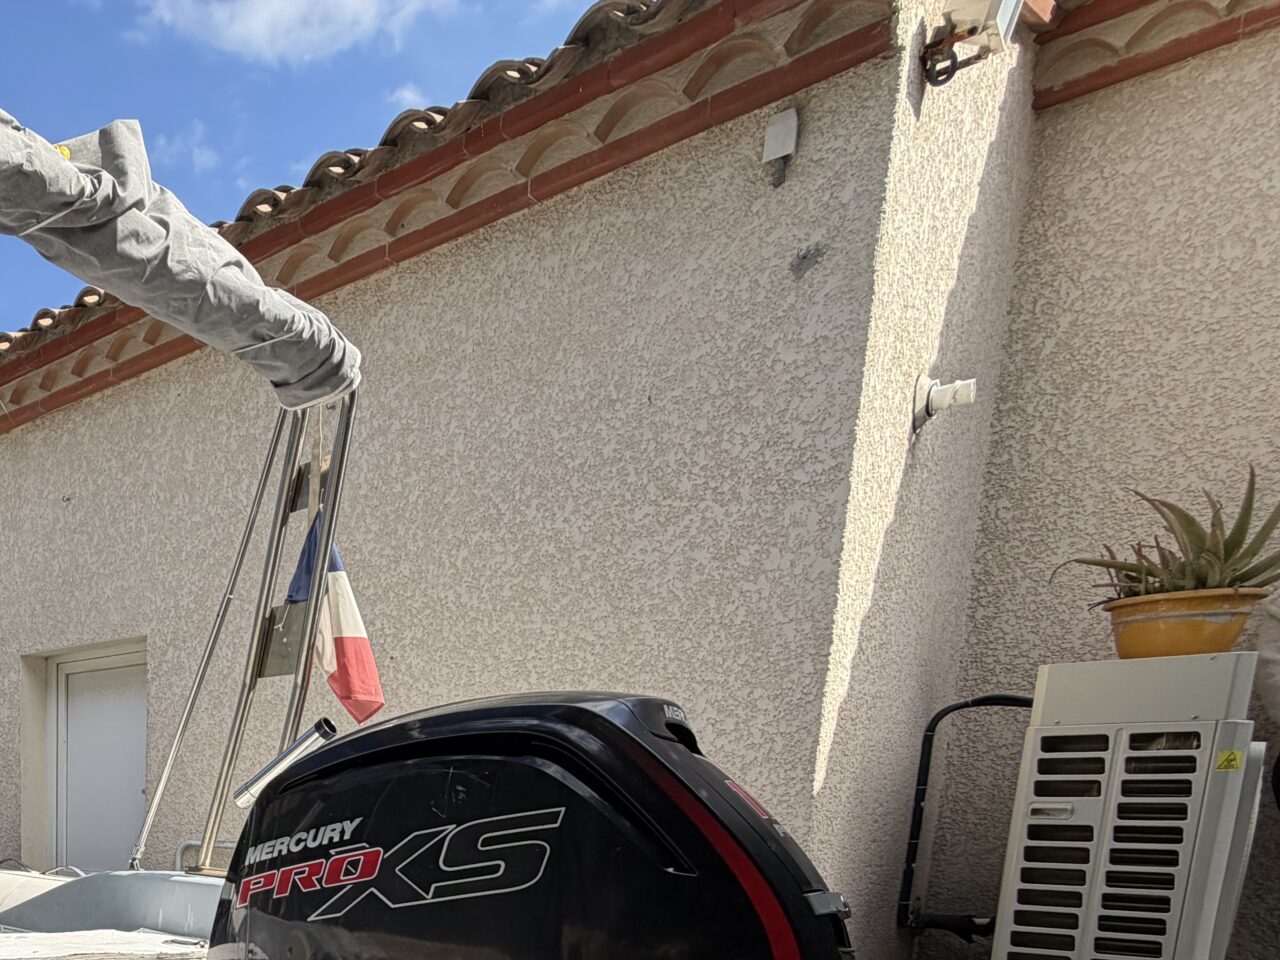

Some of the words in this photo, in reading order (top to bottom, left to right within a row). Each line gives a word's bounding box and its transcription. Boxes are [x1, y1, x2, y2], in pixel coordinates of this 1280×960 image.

[245, 816, 364, 866] MERCURY
[306, 806, 567, 922] XS
[236, 847, 383, 909] PRO
